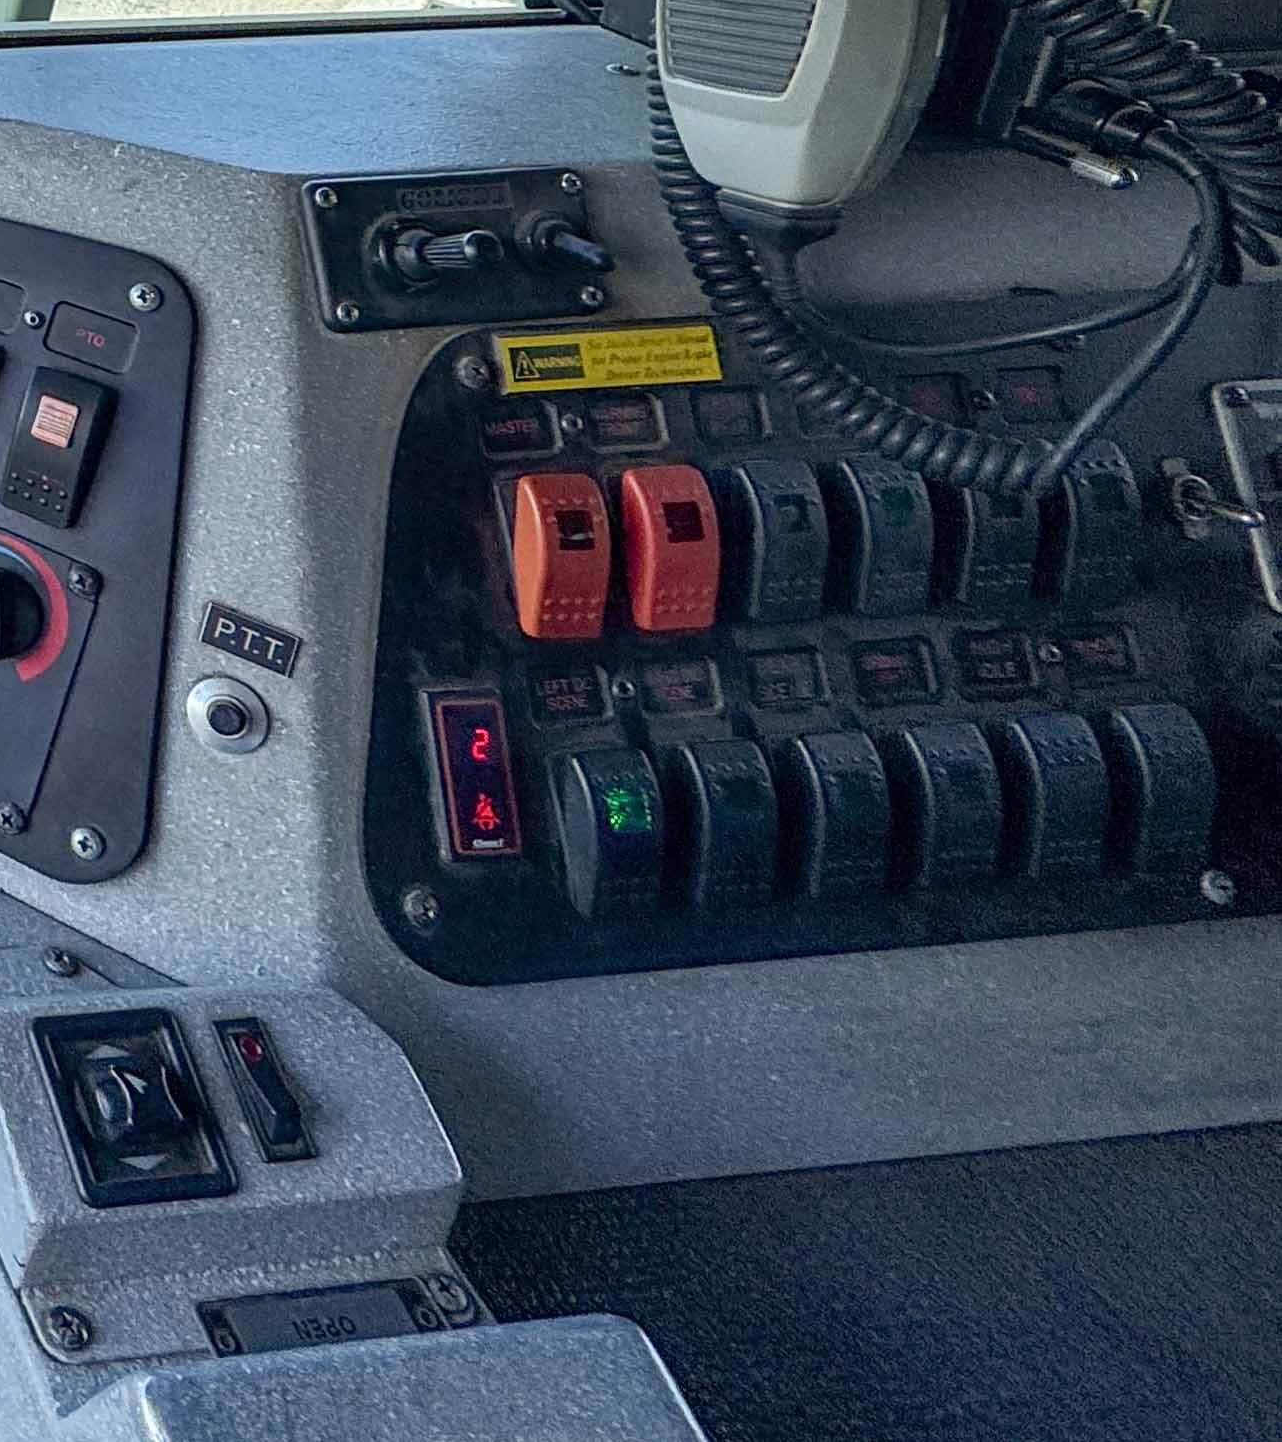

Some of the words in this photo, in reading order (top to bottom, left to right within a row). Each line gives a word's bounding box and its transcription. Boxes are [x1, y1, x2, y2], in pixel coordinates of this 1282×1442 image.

[213, 617, 285, 664] P.T.T.
[470, 727, 491, 762] 2
[292, 1315, 357, 1341] OPEN
